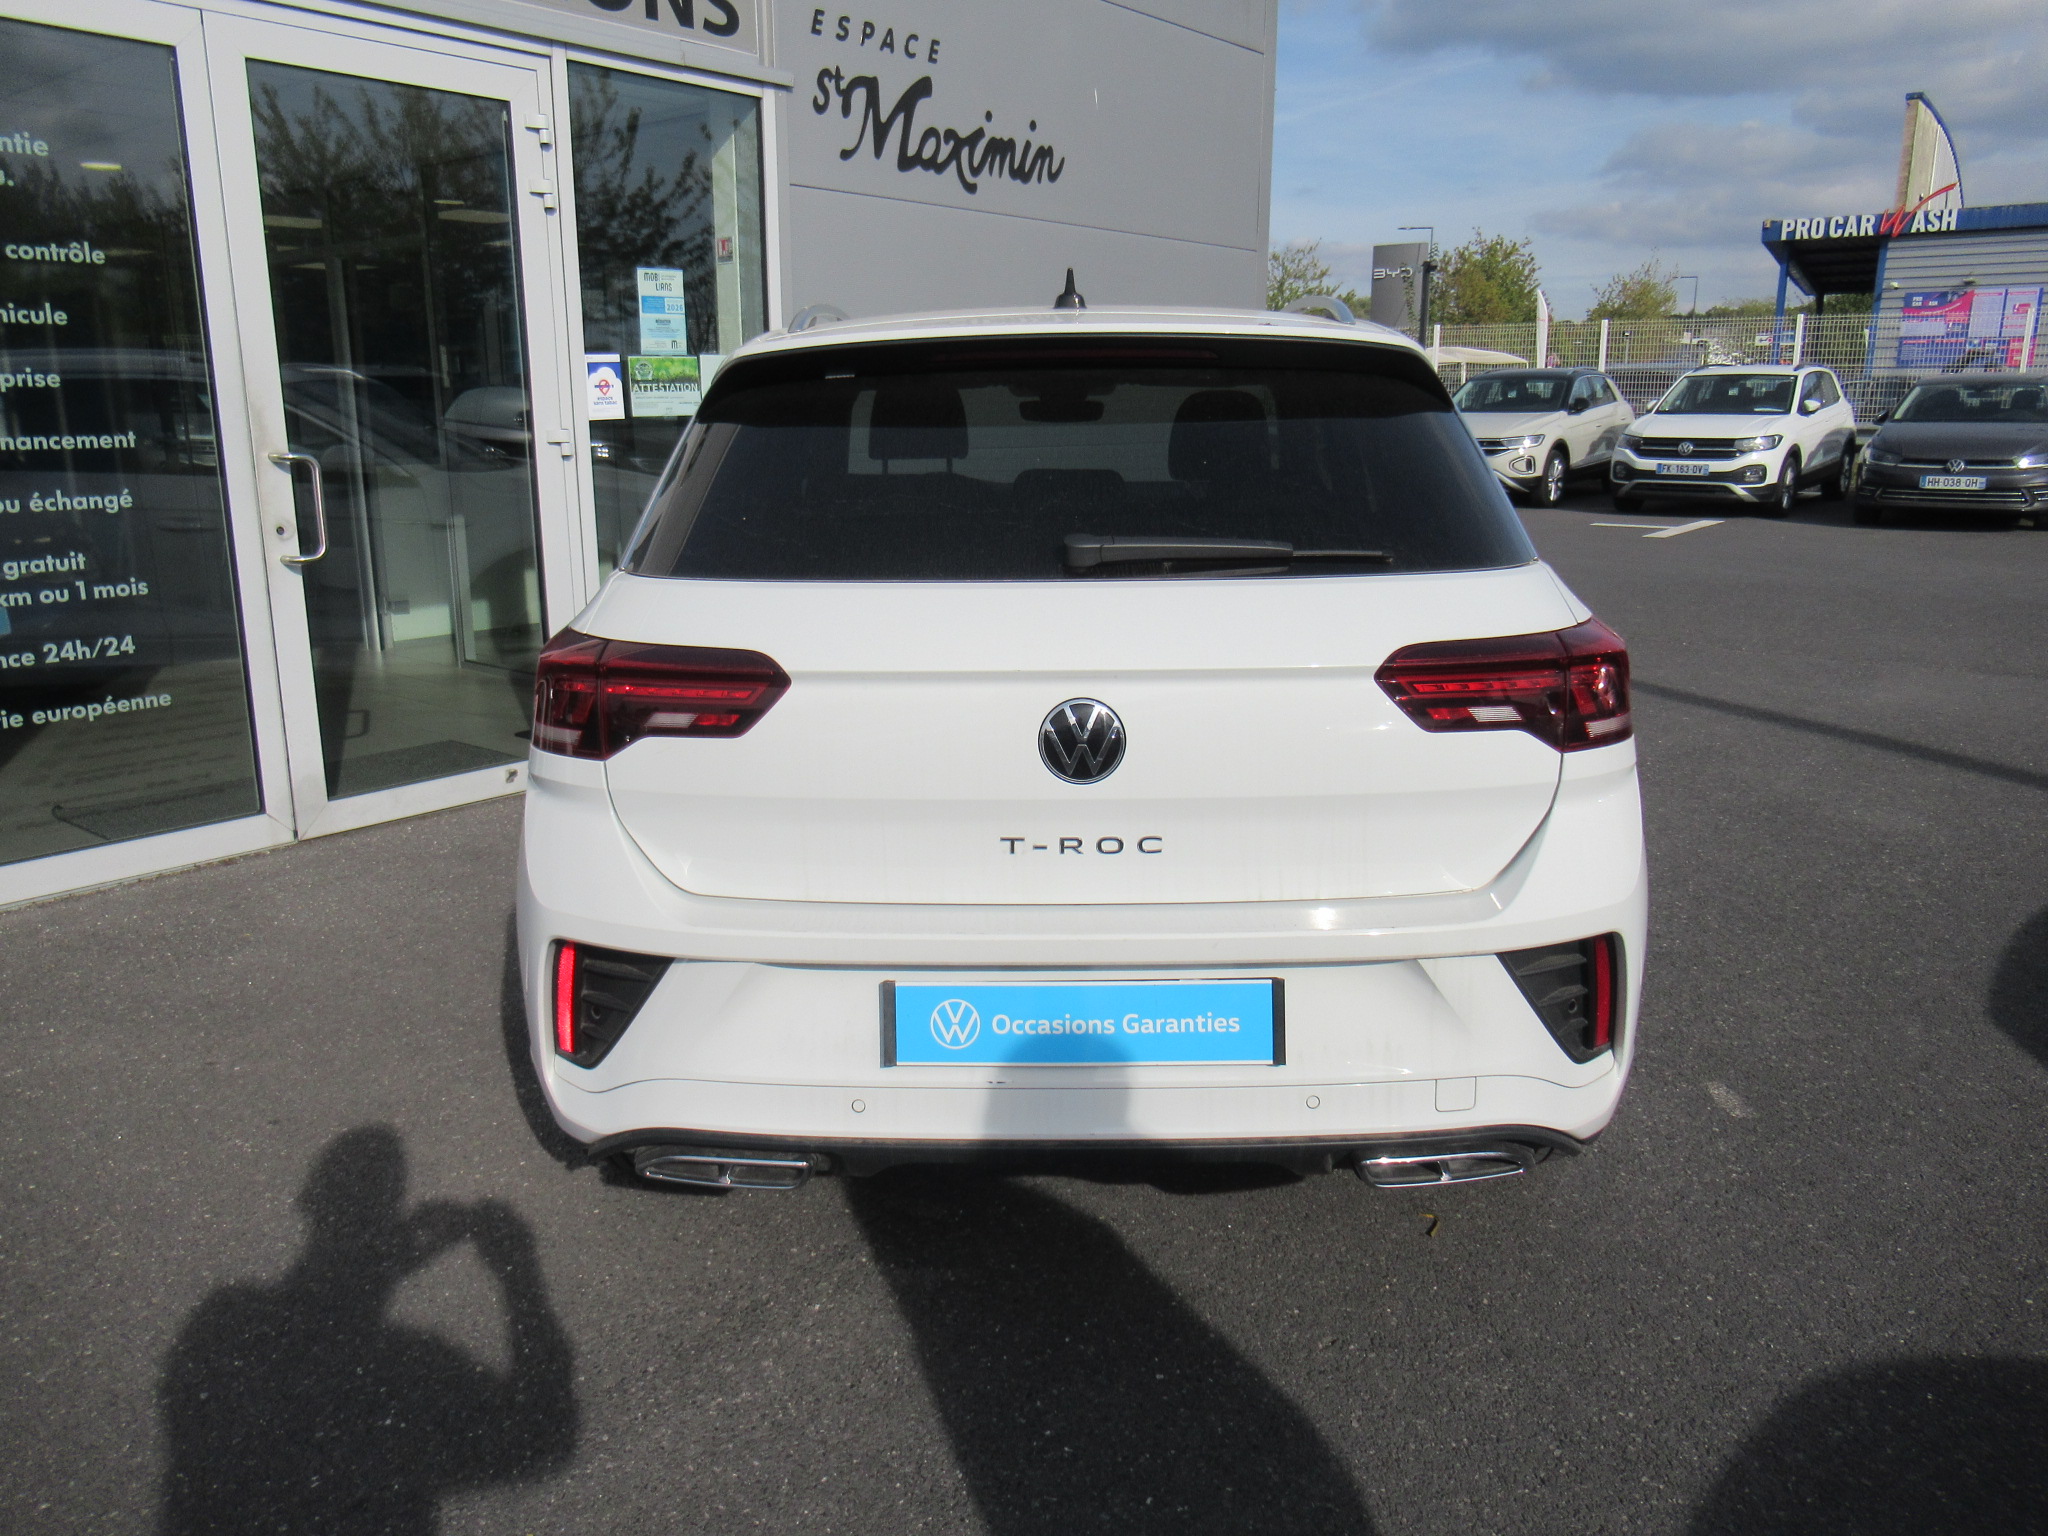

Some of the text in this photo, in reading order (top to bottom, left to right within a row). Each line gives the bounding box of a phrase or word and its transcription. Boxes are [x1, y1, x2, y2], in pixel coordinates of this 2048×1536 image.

[811, 8, 941, 64] ESPACE
[839, 75, 1066, 195] Maximin
[1780, 183, 1959, 242] PRO CAR WASH
[5, 241, 107, 265] contrôle
[1373, 267, 1413, 279] BYD
[633, 382, 699, 393] ATTESTATION
[29, 488, 133, 514] échangé
[3, 551, 86, 581] gratuit
[39, 588, 70, 604] ou
[75, 580, 87, 600] 1
[93, 577, 149, 599] mois
[43, 634, 136, 664] 24h/24
[32, 694, 172, 722] européenne
[1000, 836, 1163, 855] T-ROC
[992, 1013, 1115, 1036] Occasions
[1122, 1011, 1241, 1034] Garanties
